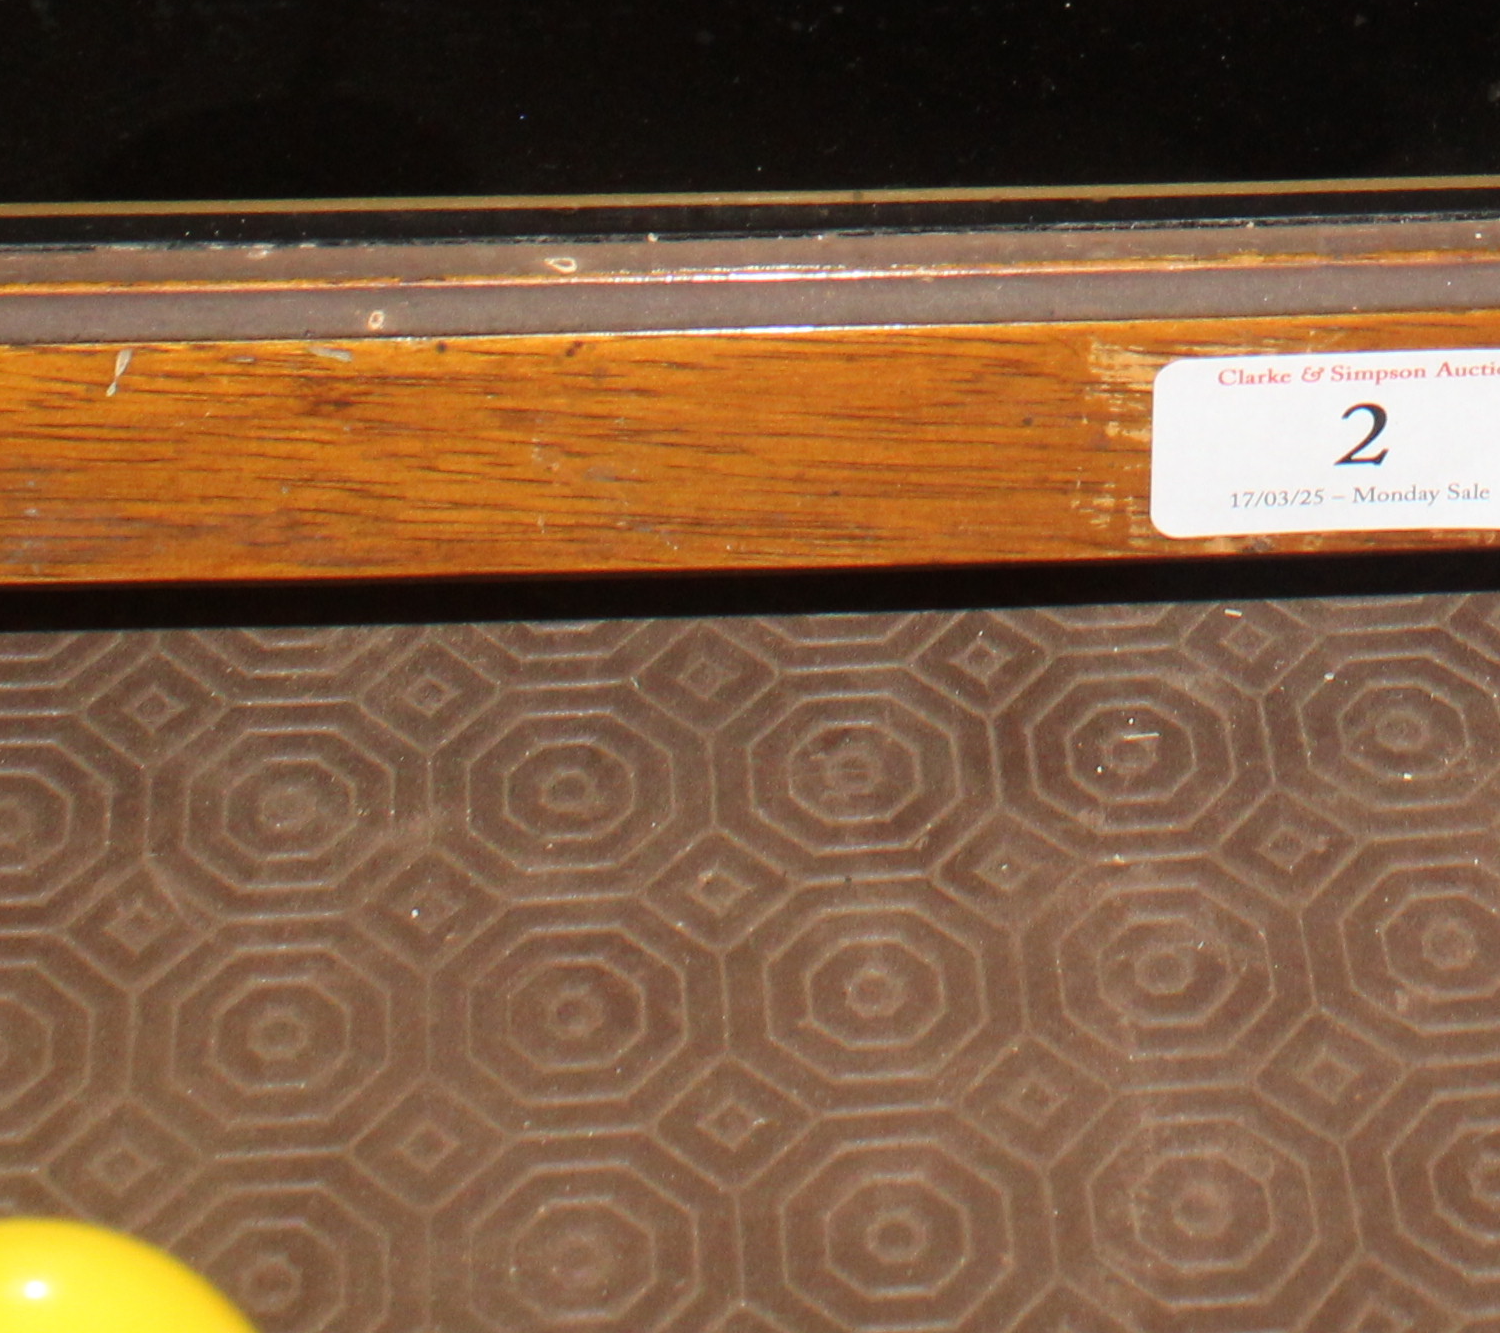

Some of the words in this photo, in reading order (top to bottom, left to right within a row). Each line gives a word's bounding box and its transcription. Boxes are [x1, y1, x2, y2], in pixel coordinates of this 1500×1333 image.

[1217, 367, 1292, 387] Clarke
[1301, 367, 1324, 384] &
[1331, 363, 1427, 387] Simpson
[1334, 402, 1389, 467] 2
[1229, 488, 1325, 510] 17/03/25
[1352, 485, 1440, 507] Monday
[1447, 482, 1491, 502] Sale
